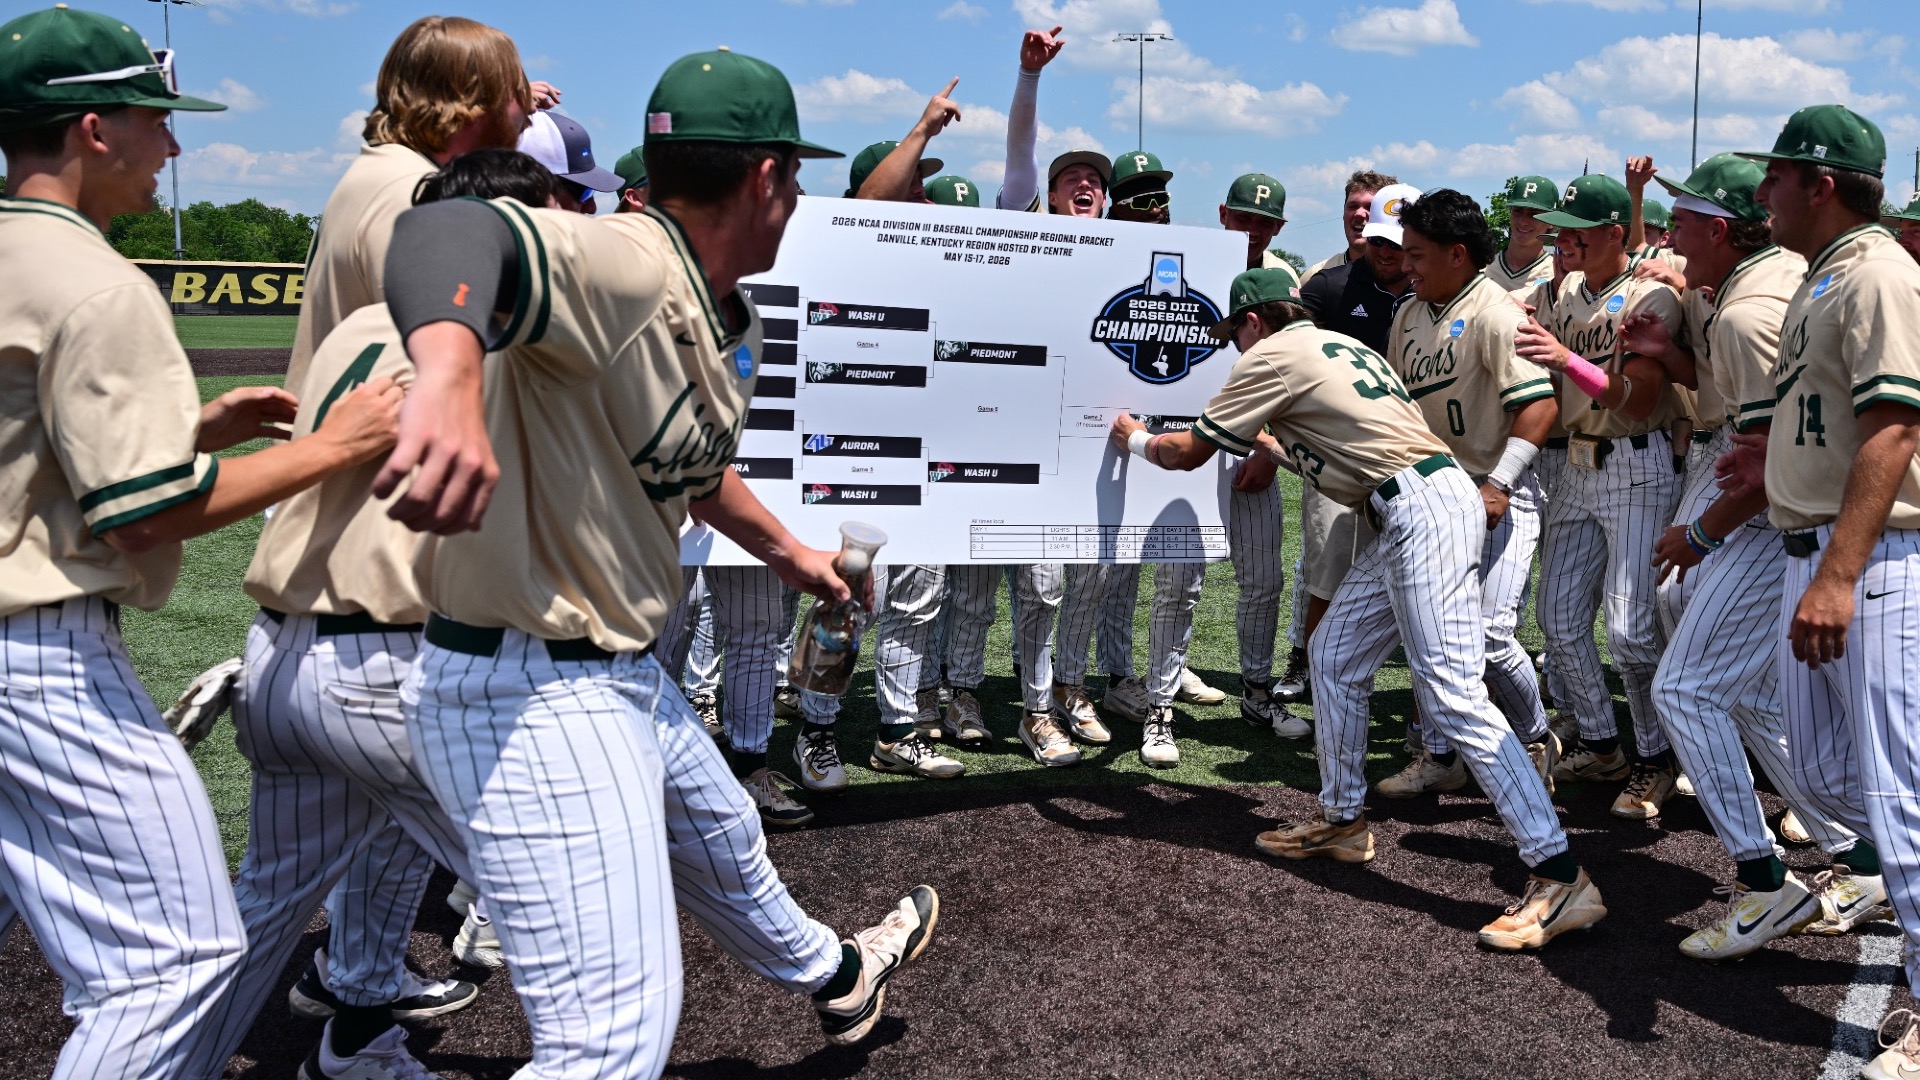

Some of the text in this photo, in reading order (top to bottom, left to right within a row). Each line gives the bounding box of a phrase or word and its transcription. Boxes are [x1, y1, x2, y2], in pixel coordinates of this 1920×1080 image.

[1133, 154, 1148, 172] P
[954, 182, 969, 203] P
[1255, 184, 1271, 205] P
[1523, 182, 1538, 198] P
[832, 216, 1114, 247] 2026 NCAA DIVISION III BASEBALL CHAMPIONSHIP REGIONAL BRACKET
[877, 234, 1073, 256] DANVILLE, KENTUCKY REGION HOSTED BY CENTRE
[944, 252, 1010, 266] MAY 15-17, 2026
[1157, 270, 1178, 278] NCAA
[1128, 299, 1200, 312] 2026 DIII
[848, 310, 876, 320] WASH
[878, 312, 886, 322] U
[1129, 310, 1198, 323] BASEBALL
[1094, 320, 1220, 346] CHAMPIONSH
[970, 348, 1018, 359] PIEDMONT
[846, 370, 896, 380] PIEDMONT
[1446, 399, 1466, 436] 0
[1795, 394, 1826, 447] 14
[840, 442, 880, 450] AURORA
[964, 468, 990, 477] WASH
[991, 469, 998, 477] U
[841, 490, 869, 499] WASH
[871, 491, 878, 499] U
